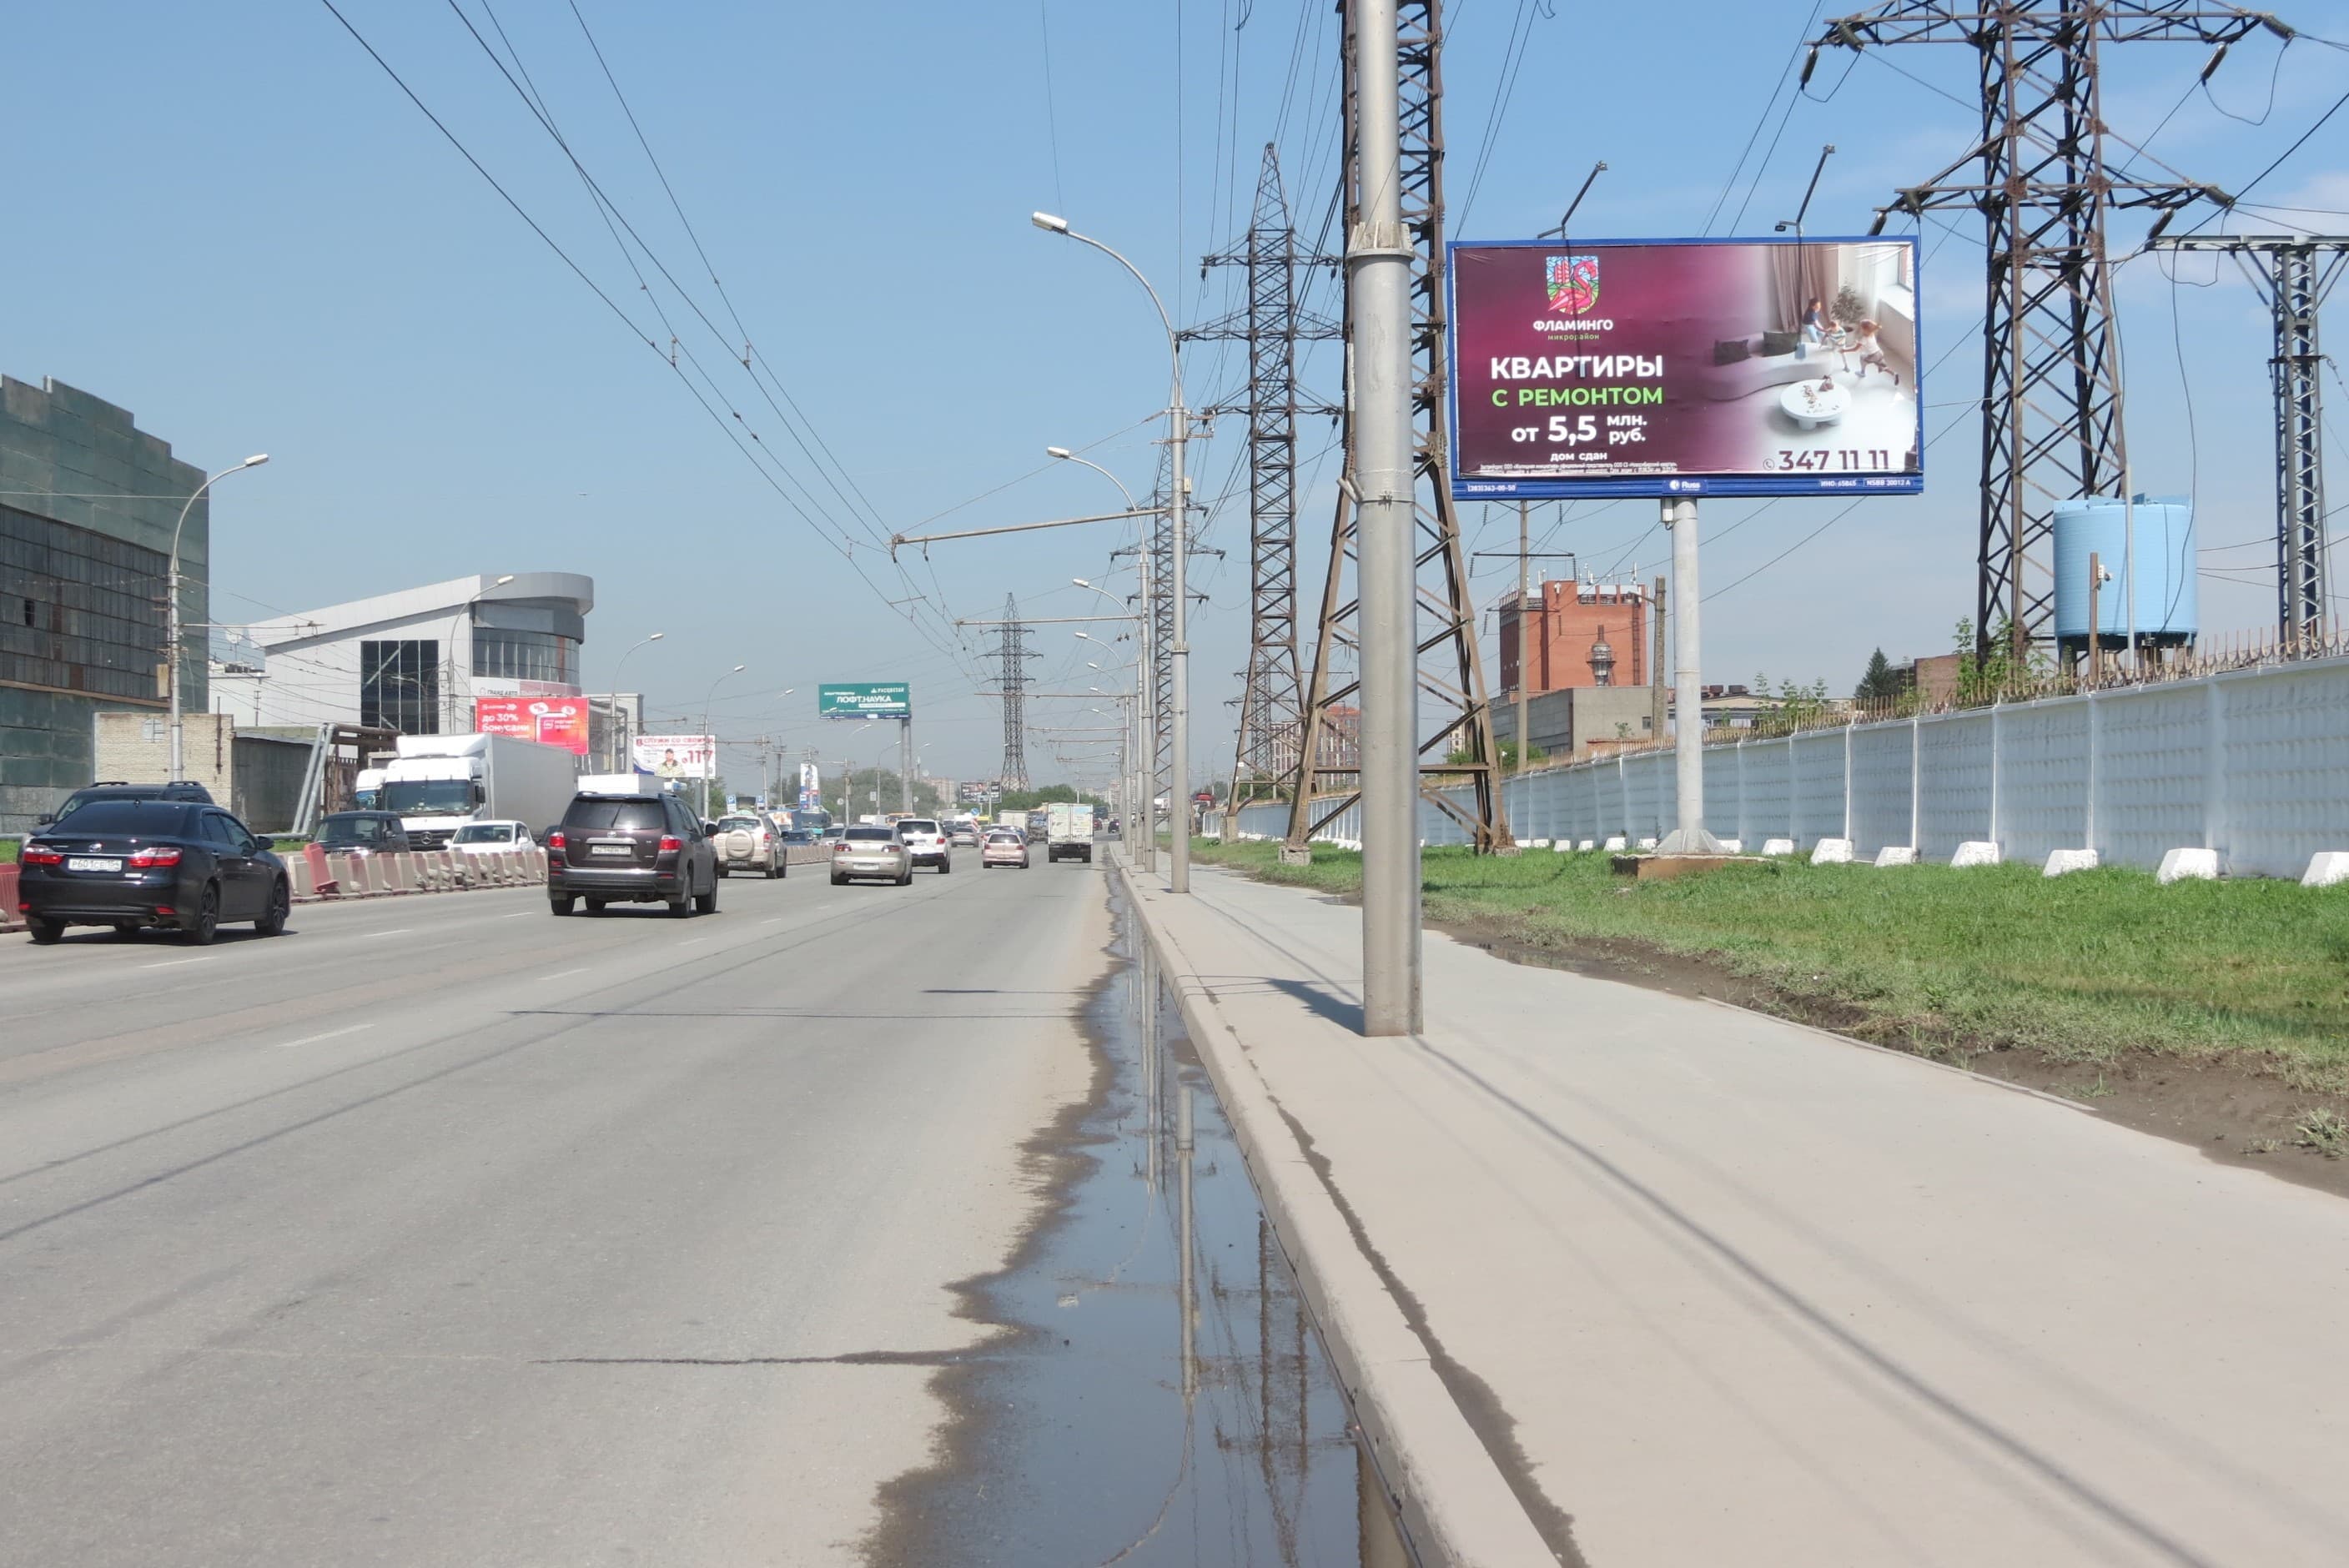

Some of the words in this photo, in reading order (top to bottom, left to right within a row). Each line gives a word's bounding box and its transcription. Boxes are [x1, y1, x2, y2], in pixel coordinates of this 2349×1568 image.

[1532, 319, 1614, 332] ФЛАМИНГО
[1491, 355, 1663, 379] КВАРТИРЫ
[1491, 389, 1508, 407] С
[1518, 387, 1663, 406] РЕМОНТОМ
[1511, 427, 1539, 442] от
[1547, 415, 1597, 446] 5,5
[1608, 428, 1646, 445] руб.
[1550, 454, 1575, 462] дом
[1578, 453, 1607, 461] сдан
[1778, 450, 1830, 470] 347
[1838, 450, 1859, 470] 11
[1868, 450, 1889, 470] 11
[496, 713, 519, 721] 30%
[482, 723, 530, 734] бонусами
[687, 750, 713, 763] 117
